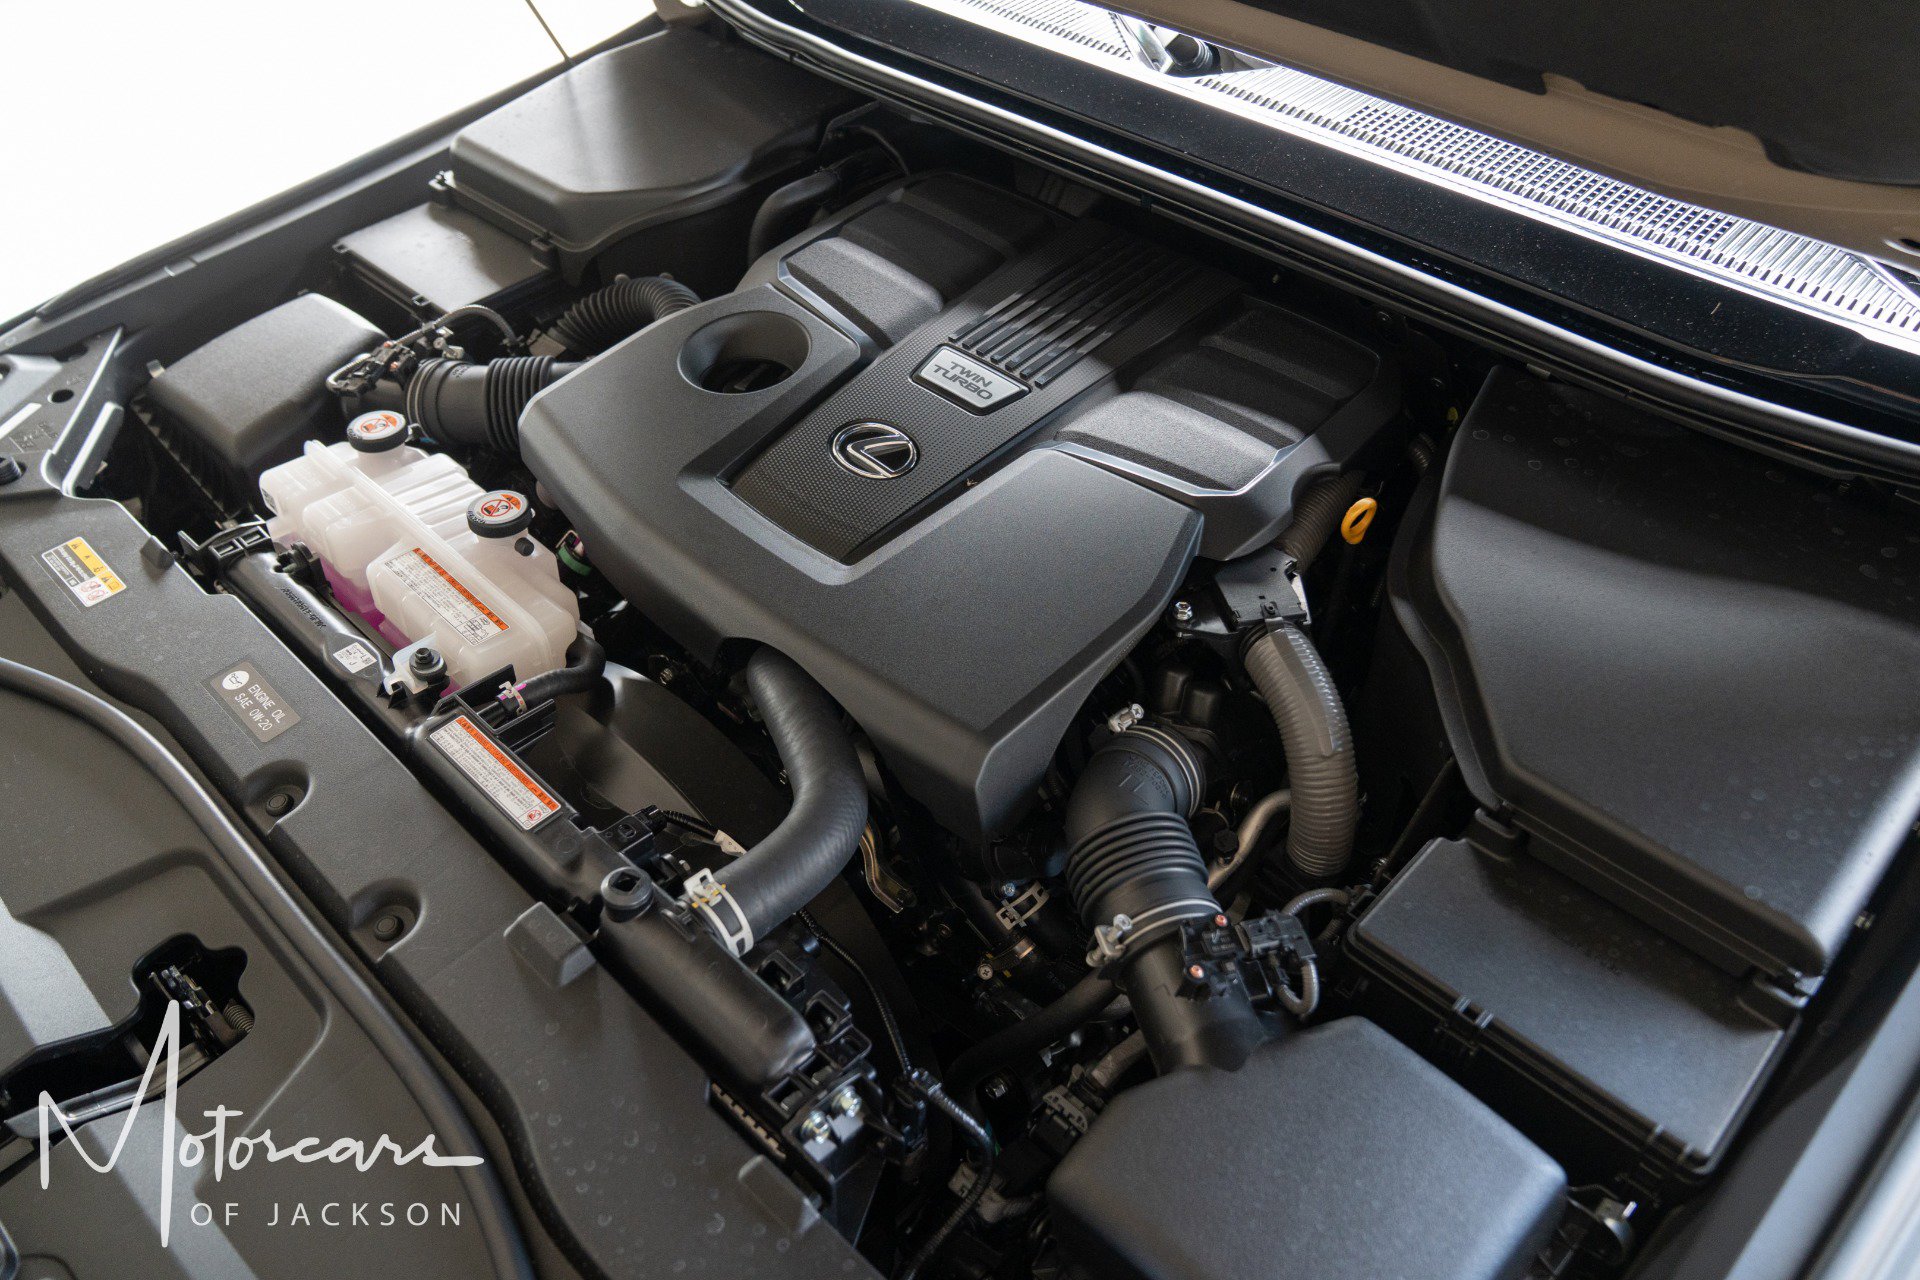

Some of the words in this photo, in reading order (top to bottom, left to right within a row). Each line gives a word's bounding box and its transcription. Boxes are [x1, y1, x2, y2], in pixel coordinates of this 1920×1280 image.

[933, 364, 993, 400] TURBO
[951, 361, 993, 388] TWIN
[234, 692, 253, 709] SAE
[249, 708, 273, 731] 0W-20
[247, 684, 276, 710] ENGINE
[271, 709, 286, 724] OIL
